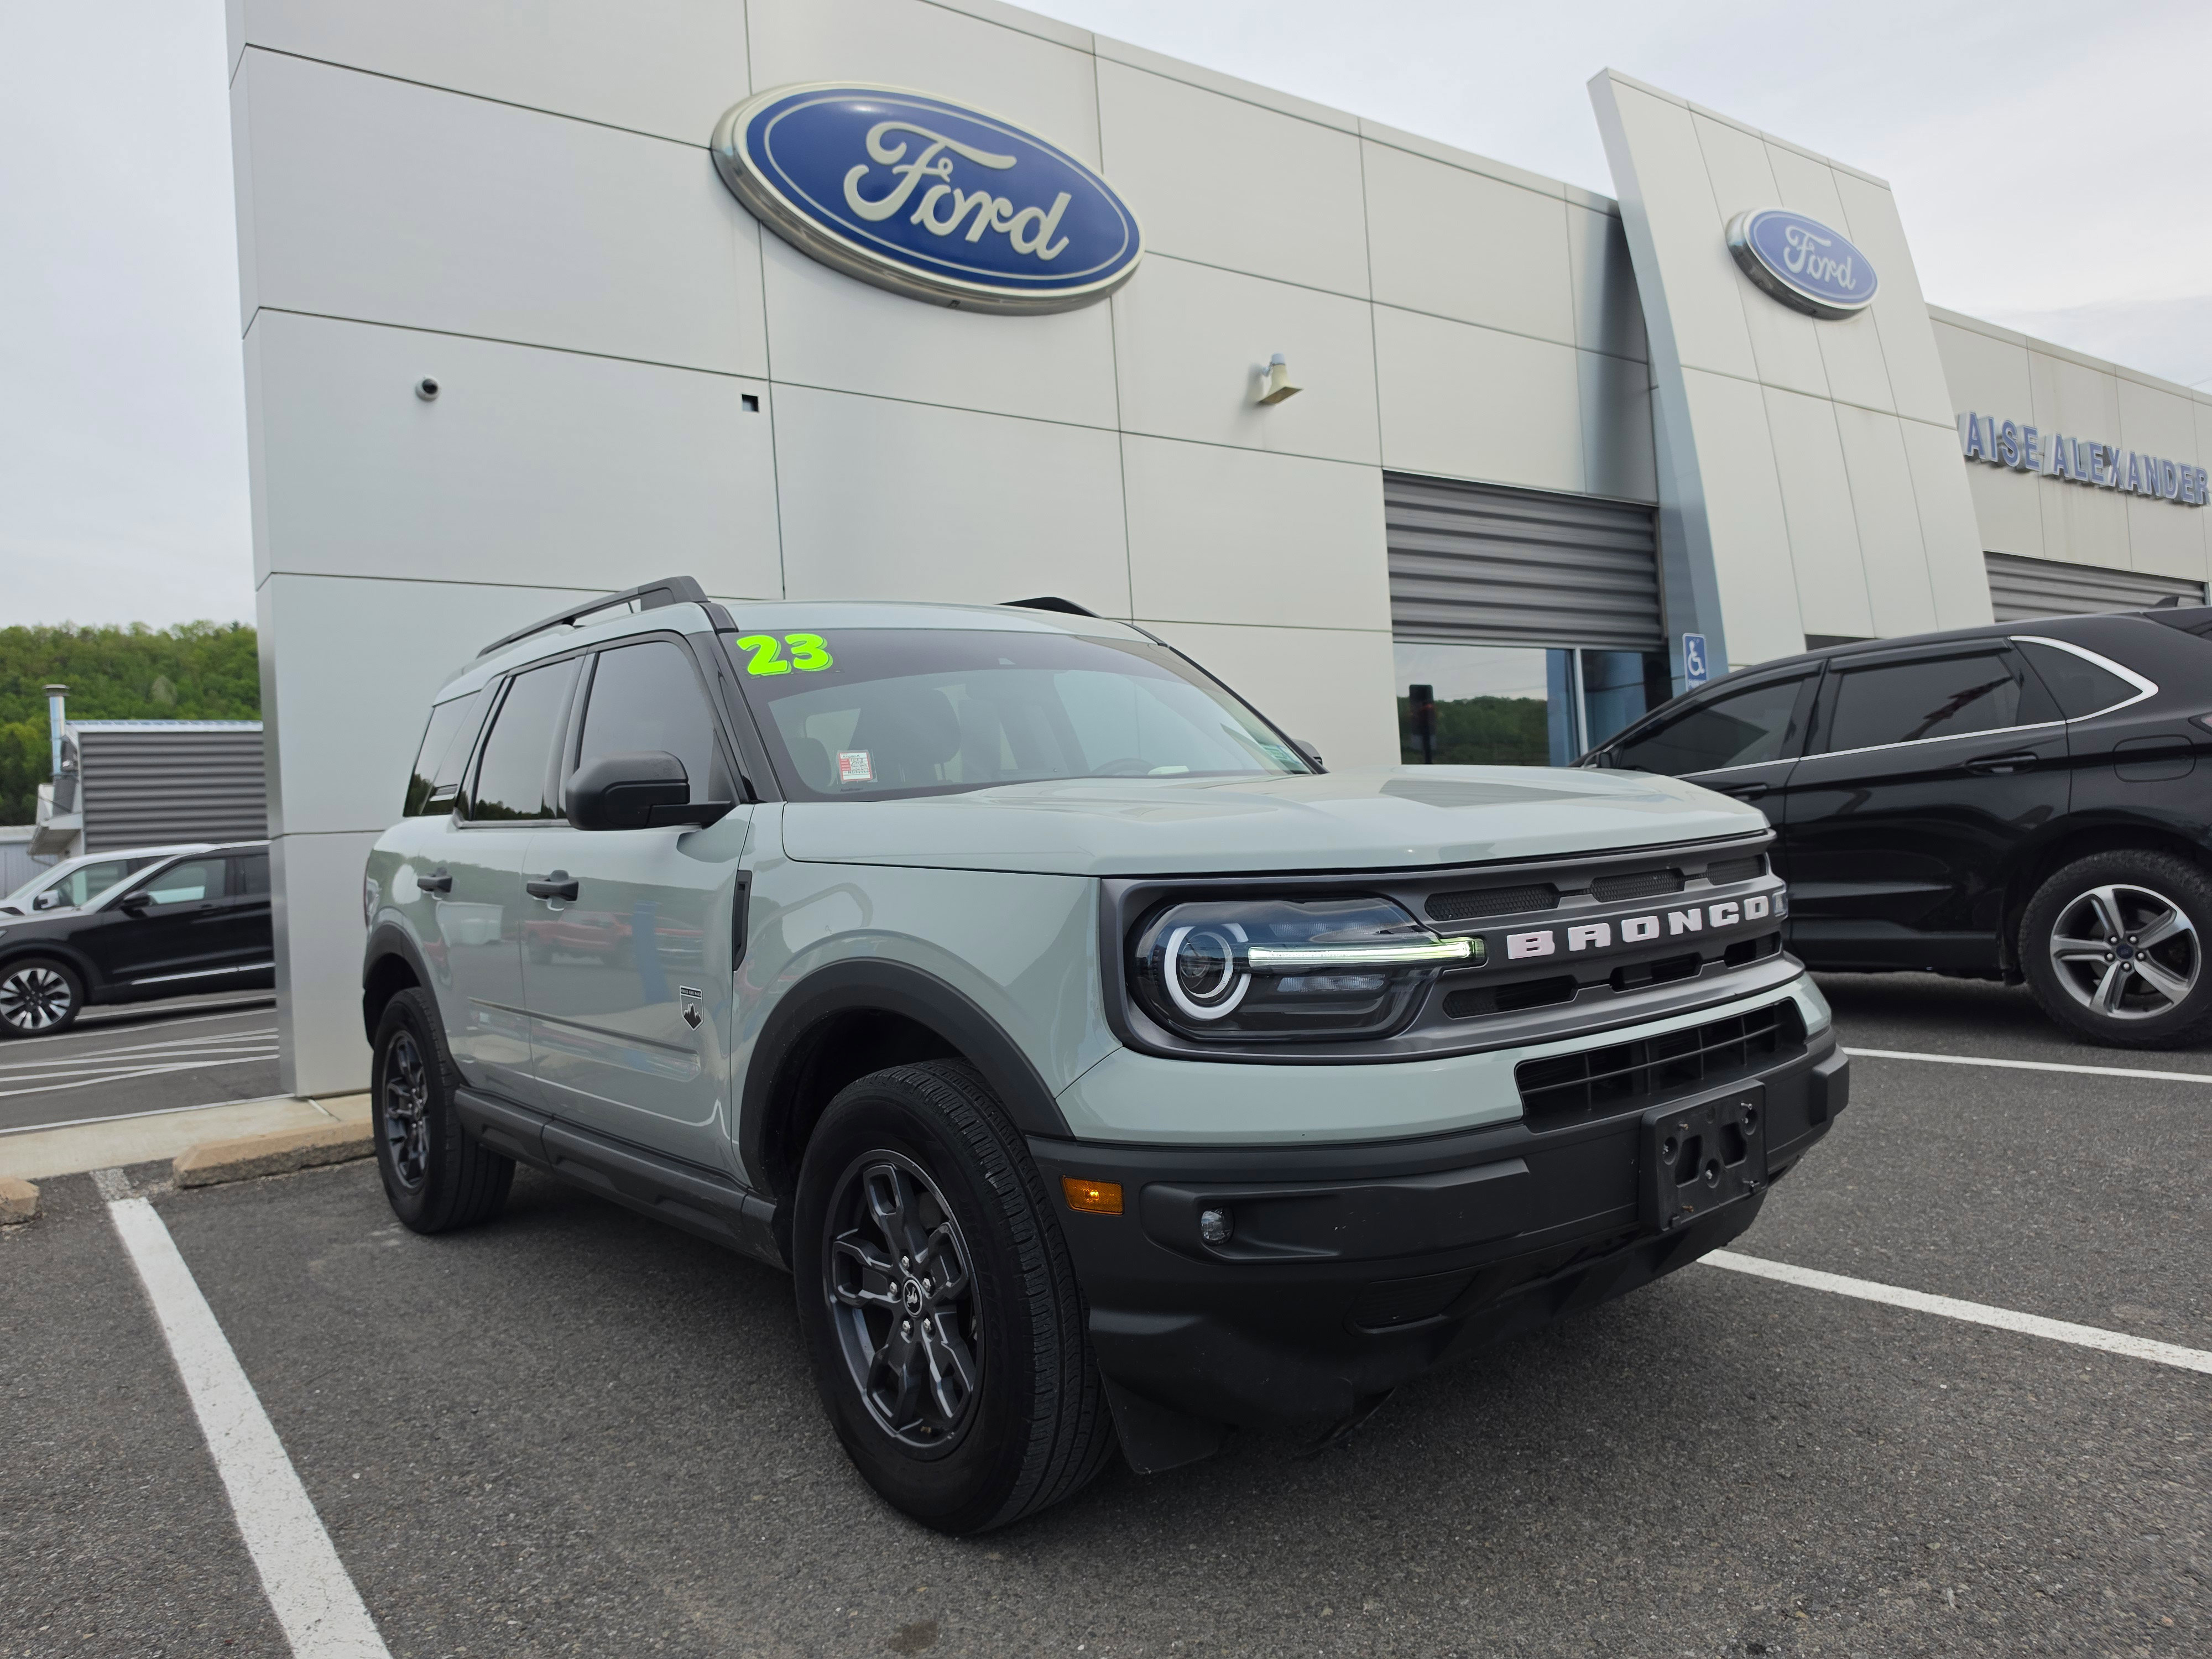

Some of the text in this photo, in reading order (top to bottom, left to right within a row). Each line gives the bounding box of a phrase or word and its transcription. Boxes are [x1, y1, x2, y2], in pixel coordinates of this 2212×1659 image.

[843, 121, 1072, 262] Ford
[1783, 225, 1857, 290] Ford
[2045, 432, 2211, 505] ALEXANDER
[736, 633, 833, 676] 23
[1506, 895, 1769, 959] BRONCO
